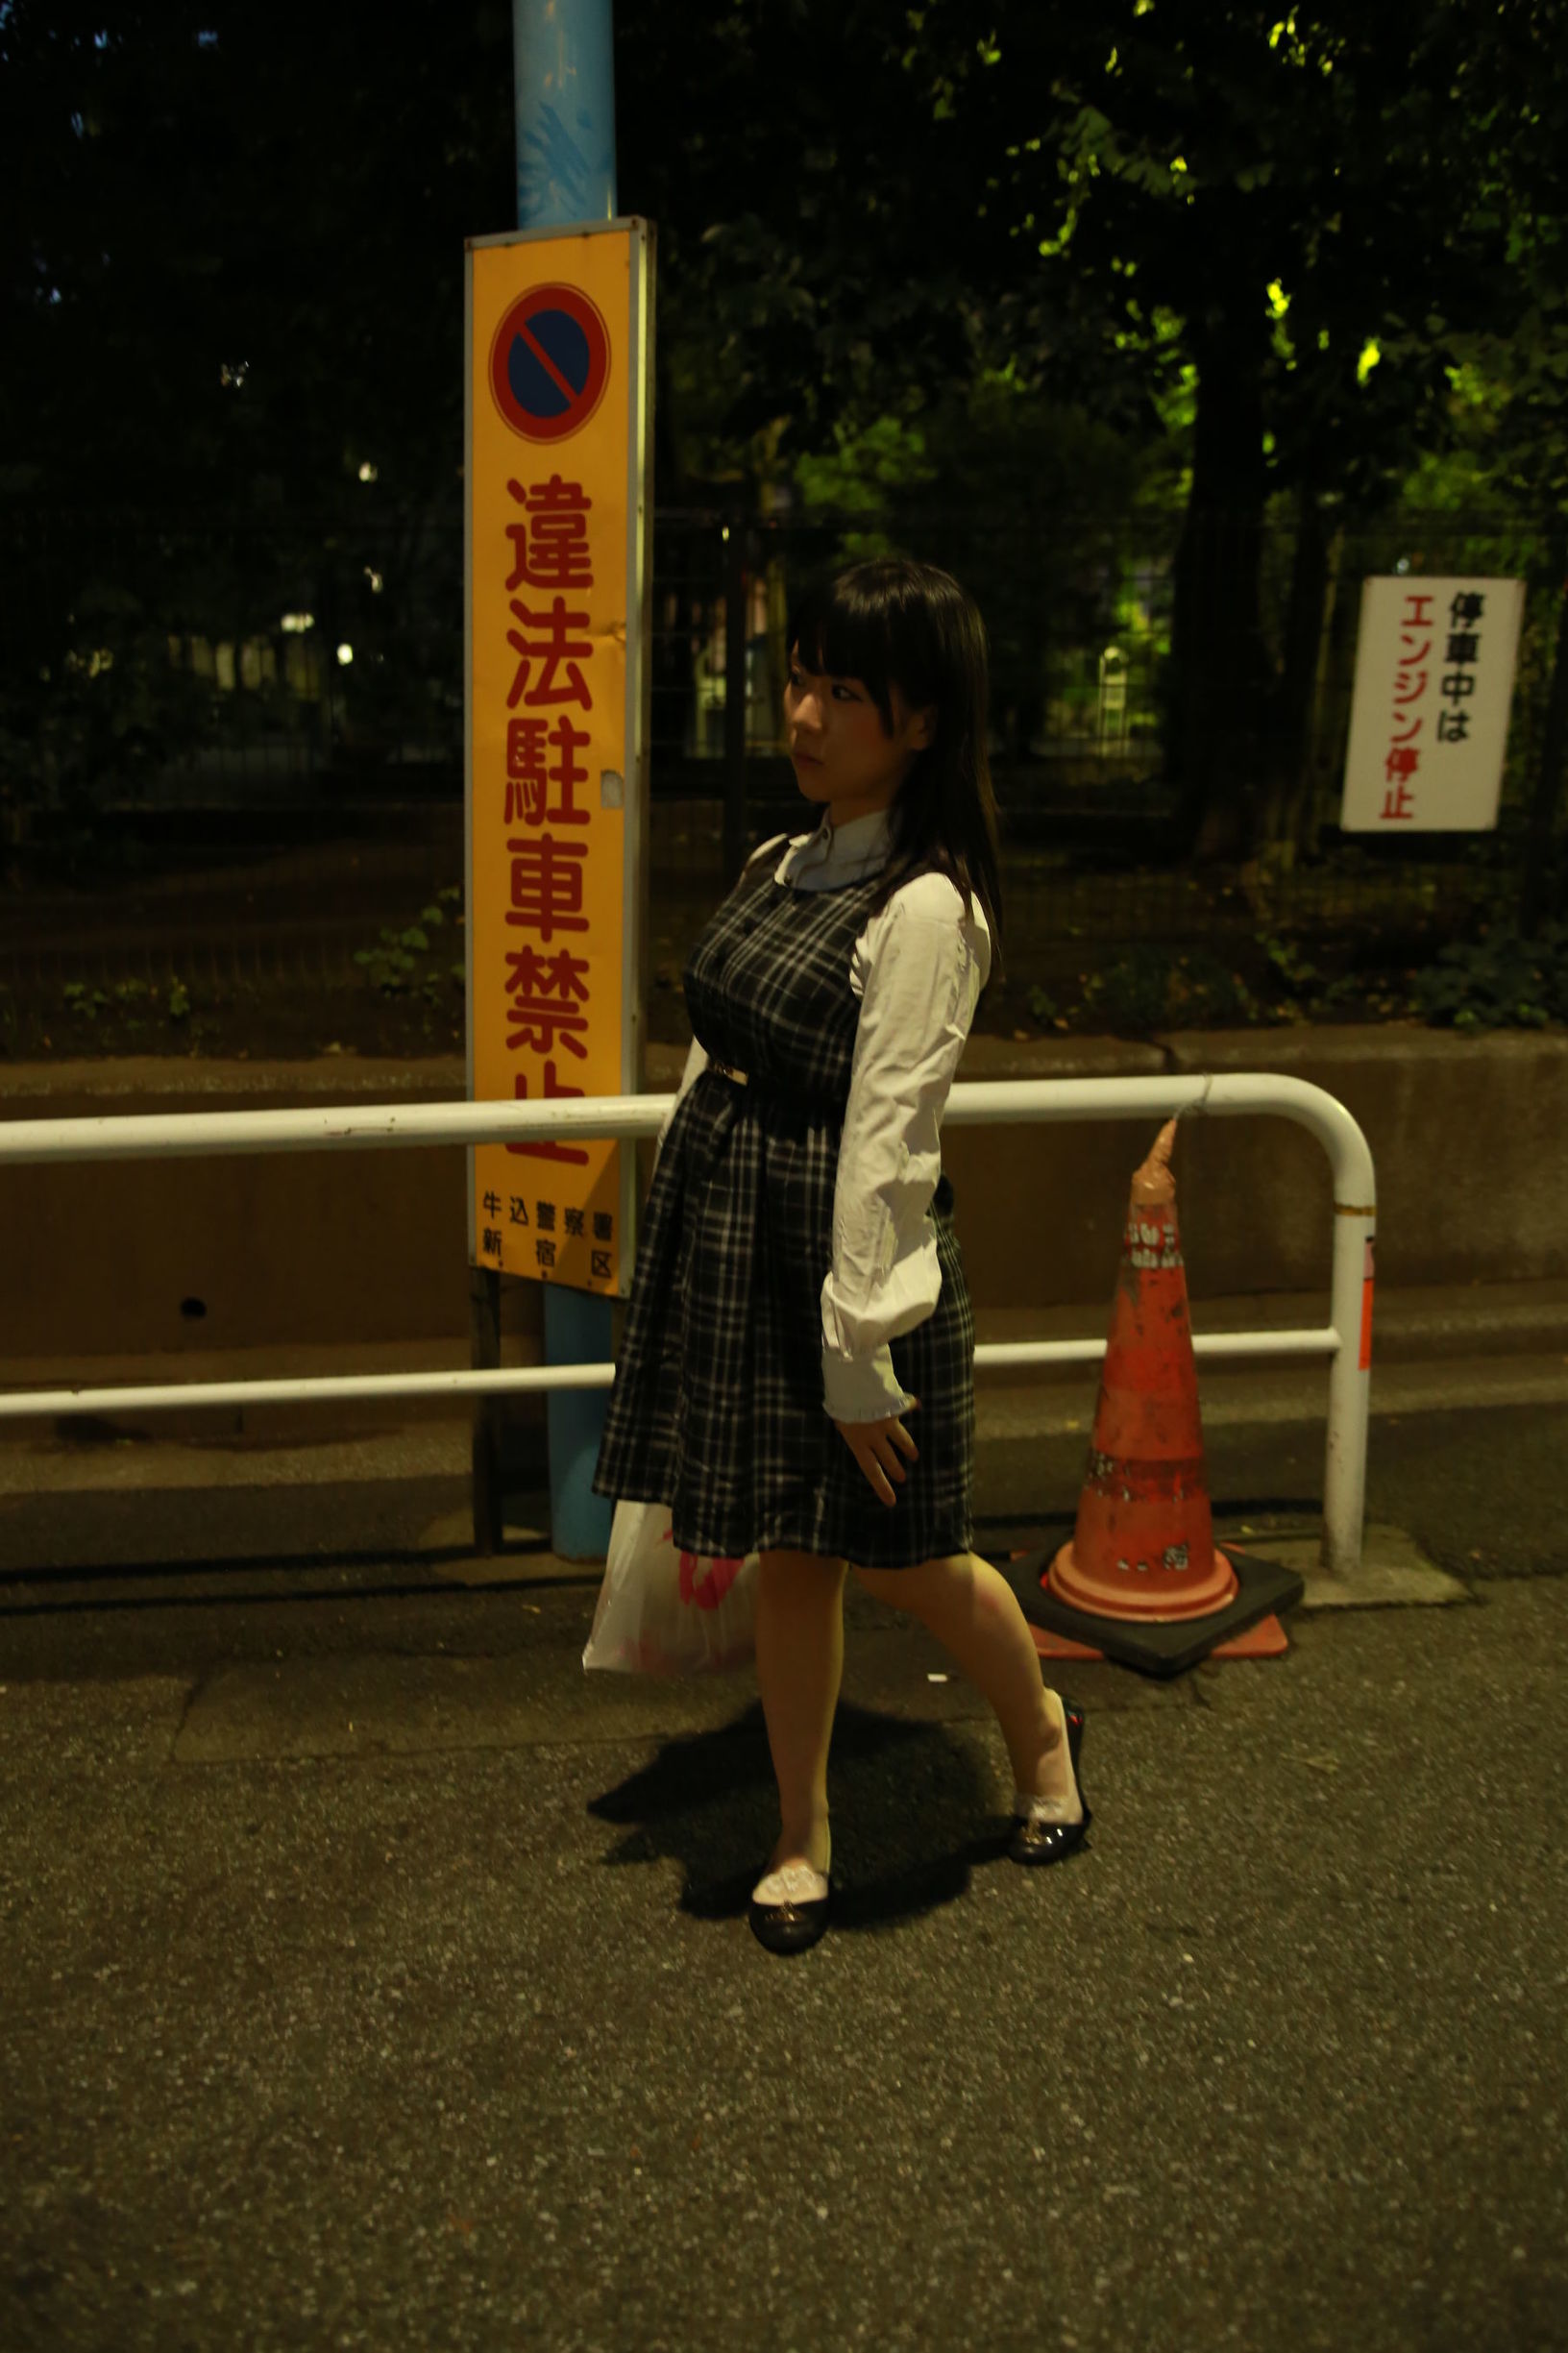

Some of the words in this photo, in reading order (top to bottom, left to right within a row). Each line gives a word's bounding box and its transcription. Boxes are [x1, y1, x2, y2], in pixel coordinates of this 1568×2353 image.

[1380, 595, 1434, 820] エンジン停止
[1437, 592, 1485, 744] 停車中は
